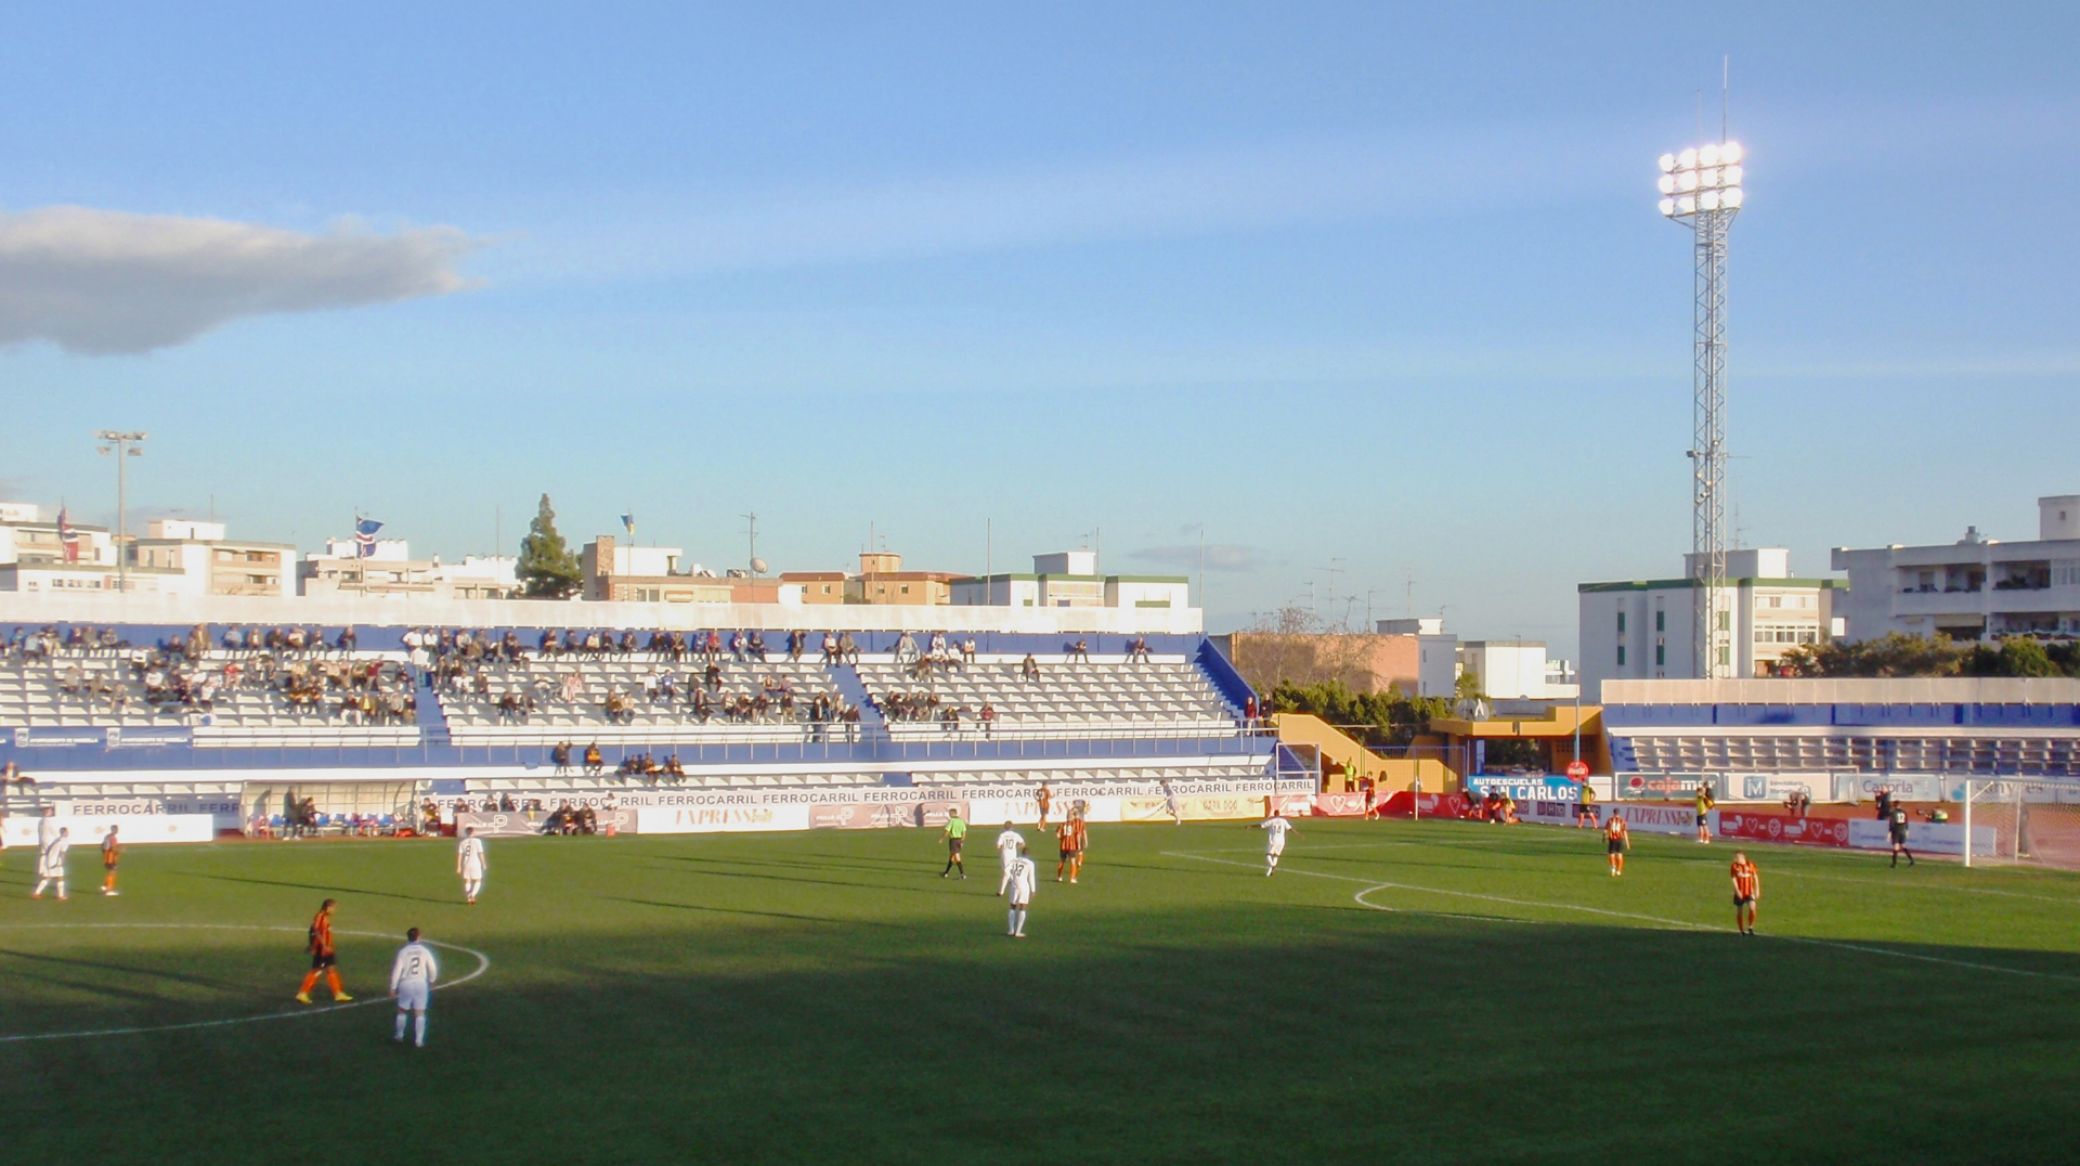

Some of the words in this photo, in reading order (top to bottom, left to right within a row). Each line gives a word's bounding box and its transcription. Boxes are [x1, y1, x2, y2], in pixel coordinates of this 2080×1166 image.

[1473, 777, 1543, 786] AUTOESCUELAS
[660, 795, 757, 806] FERROCARRIL
[763, 792, 859, 804] FERROCARRIL
[863, 789, 957, 801] FERROCARRIL
[1057, 786, 1143, 797] FERROCARRIL
[1148, 783, 1231, 796] FEROCARRIL
[1517, 786, 1578, 800] CARLOS
[73, 803, 190, 816] FERROCARRIL
[410, 957, 420, 975] 2
